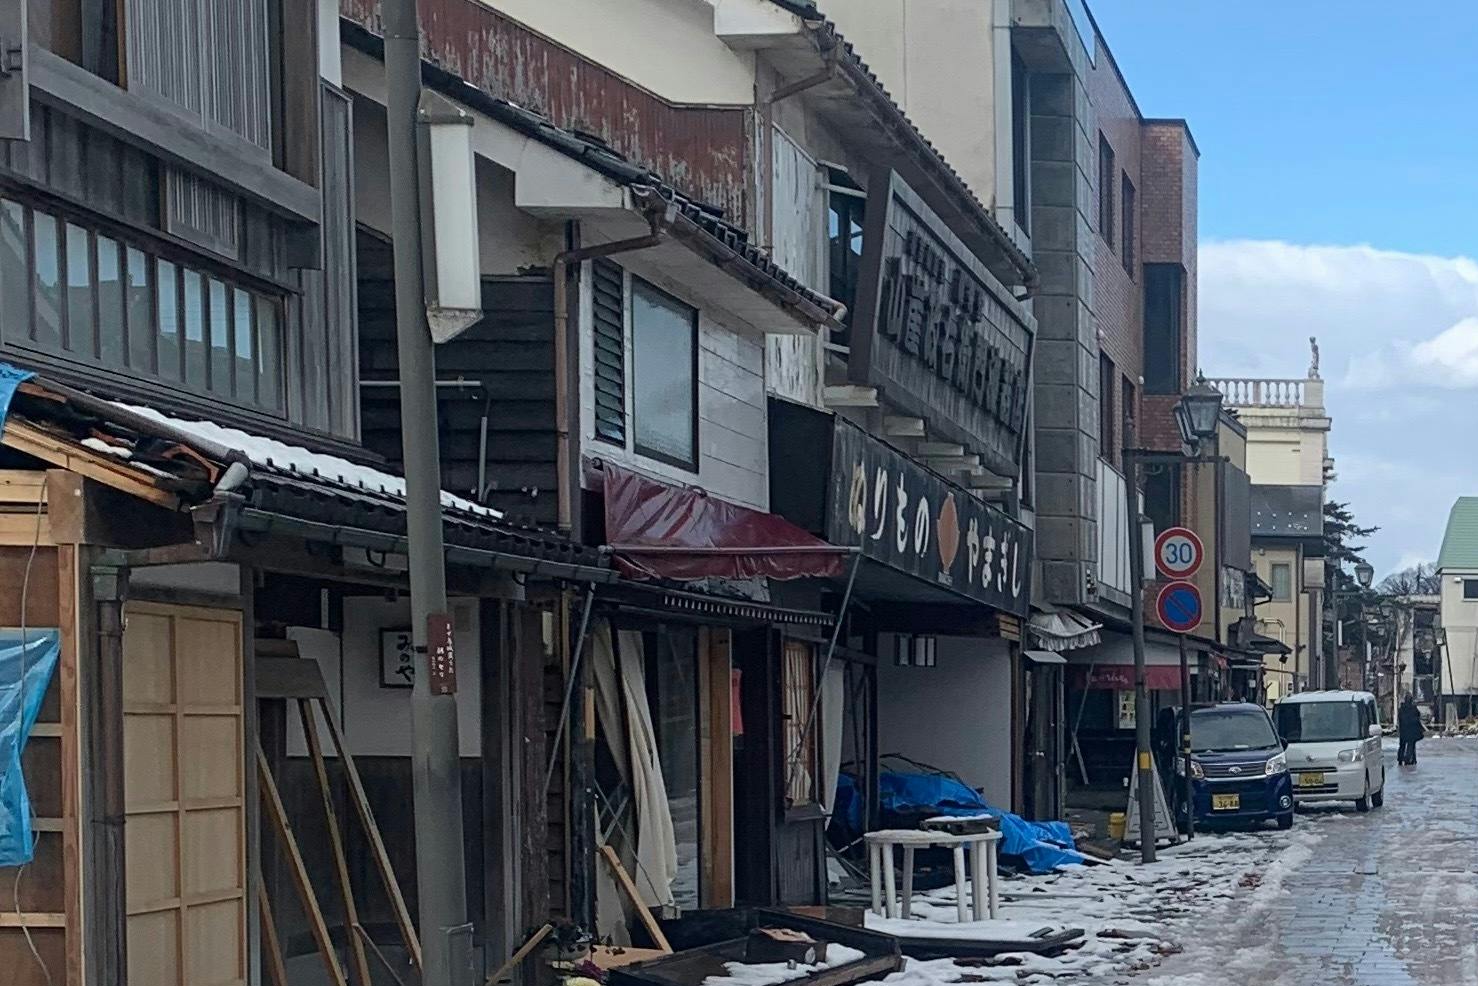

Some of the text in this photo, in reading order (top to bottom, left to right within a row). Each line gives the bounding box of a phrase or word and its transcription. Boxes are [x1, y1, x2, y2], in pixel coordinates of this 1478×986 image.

[967, 517, 1021, 598] やまぎし
[1165, 542, 1193, 565] 30
